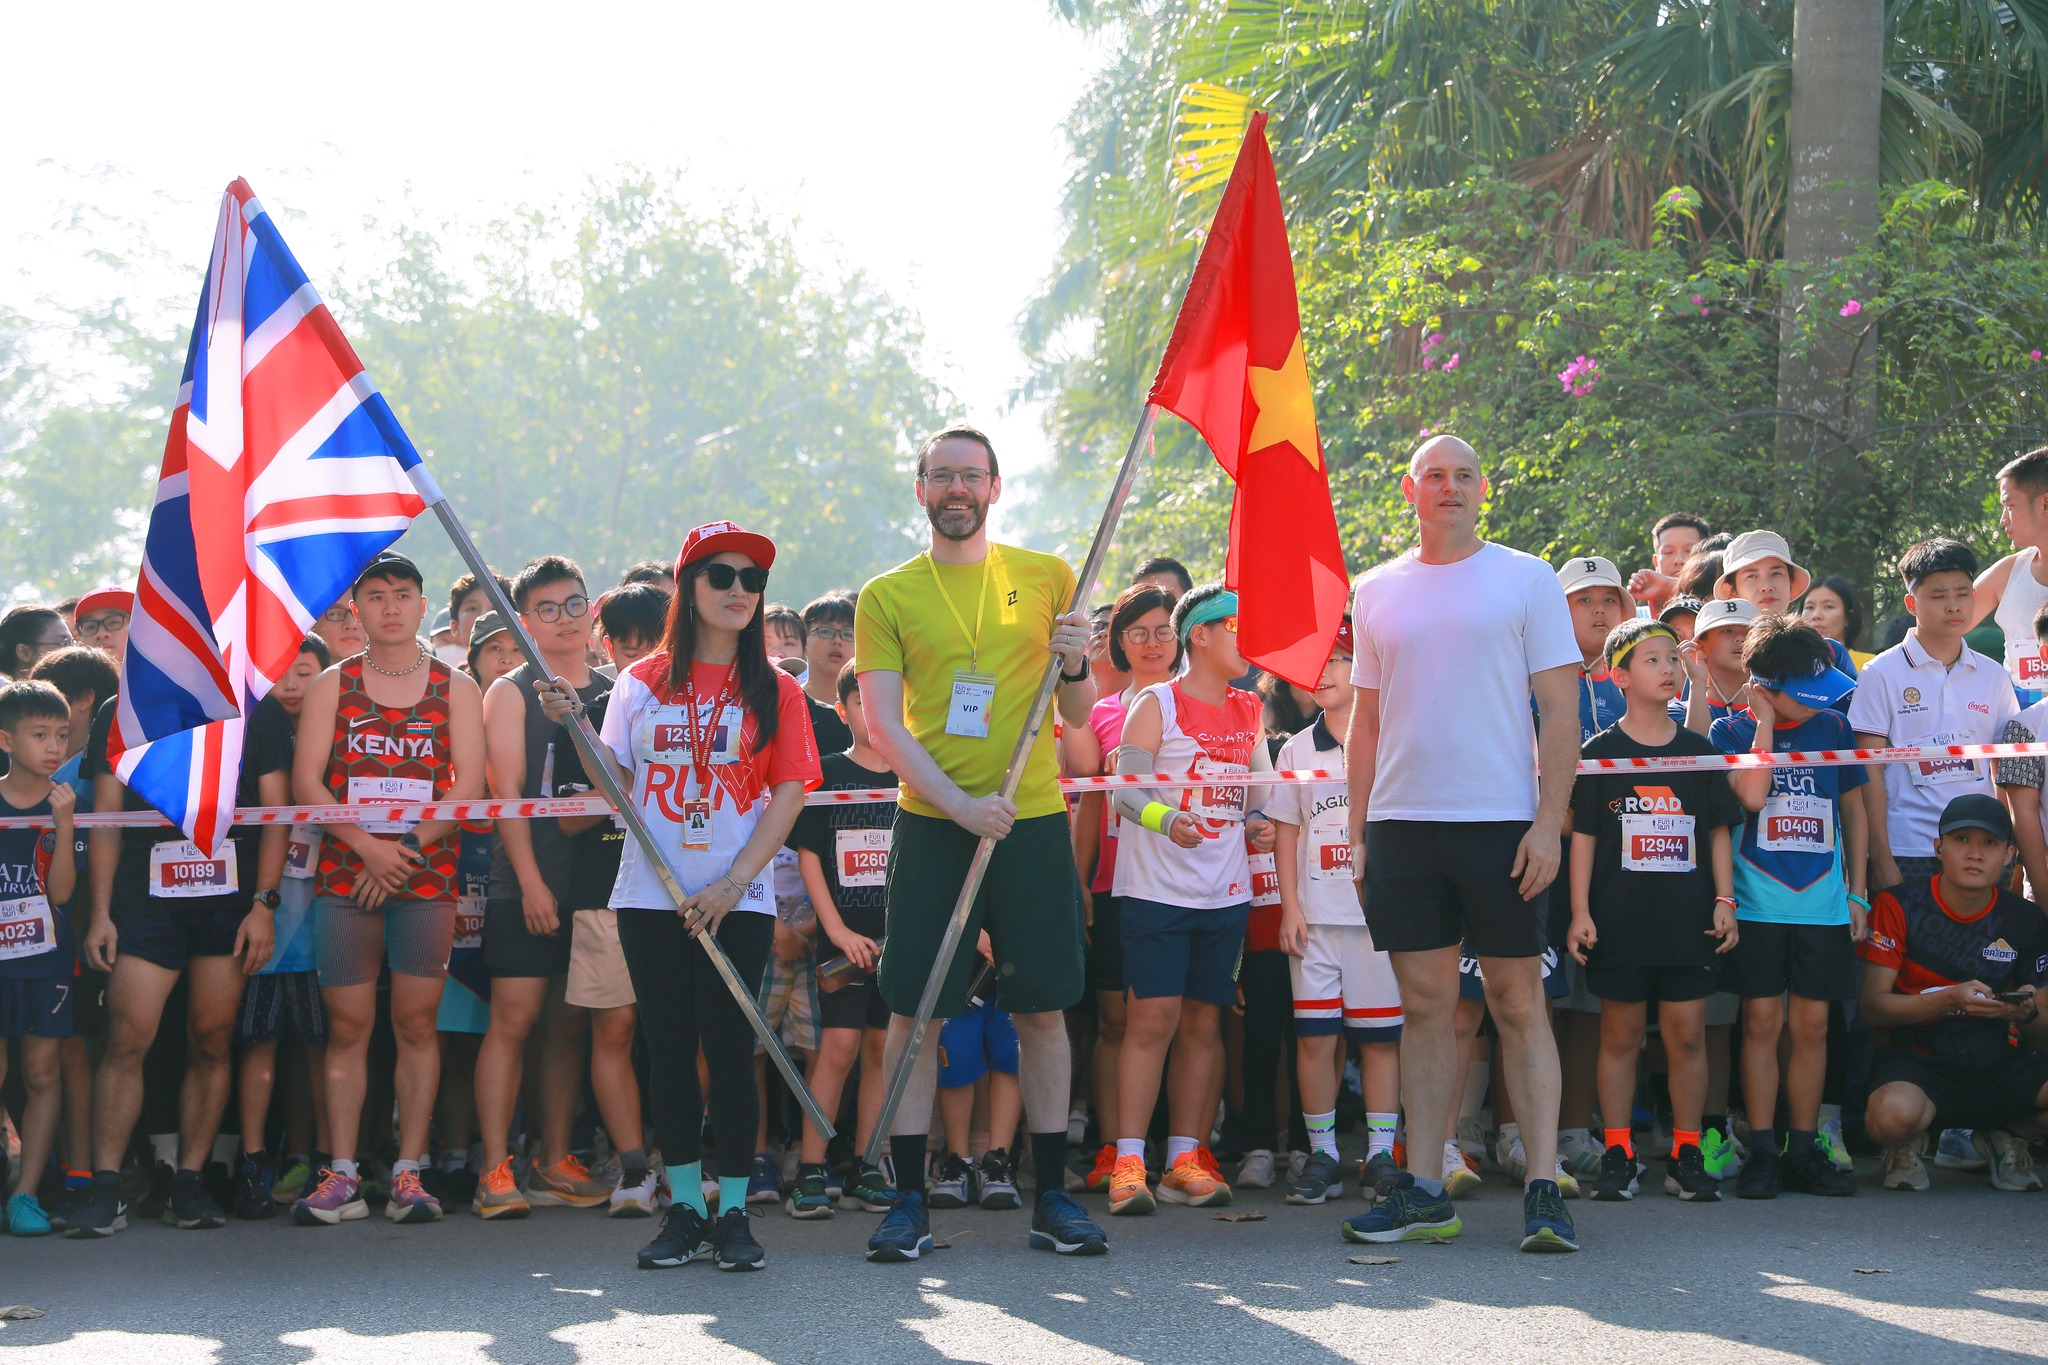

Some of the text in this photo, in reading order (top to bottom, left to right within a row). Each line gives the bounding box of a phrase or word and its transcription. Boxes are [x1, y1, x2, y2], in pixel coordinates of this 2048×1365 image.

[1584, 561, 1597, 573] B
[1725, 602, 1737, 613] B
[963, 704, 978, 713] VIP
[347, 734, 434, 758] KENYA
[1772, 773, 1816, 793] FUN
[1211, 786, 1242, 803] 12422
[1625, 797, 1682, 812] ROAD
[1775, 819, 1818, 834] 10406
[1640, 838, 1683, 853] 12944
[172, 863, 215, 880] 10189
[747, 890, 764, 899] RUN
[51, 985, 69, 1014] 7
